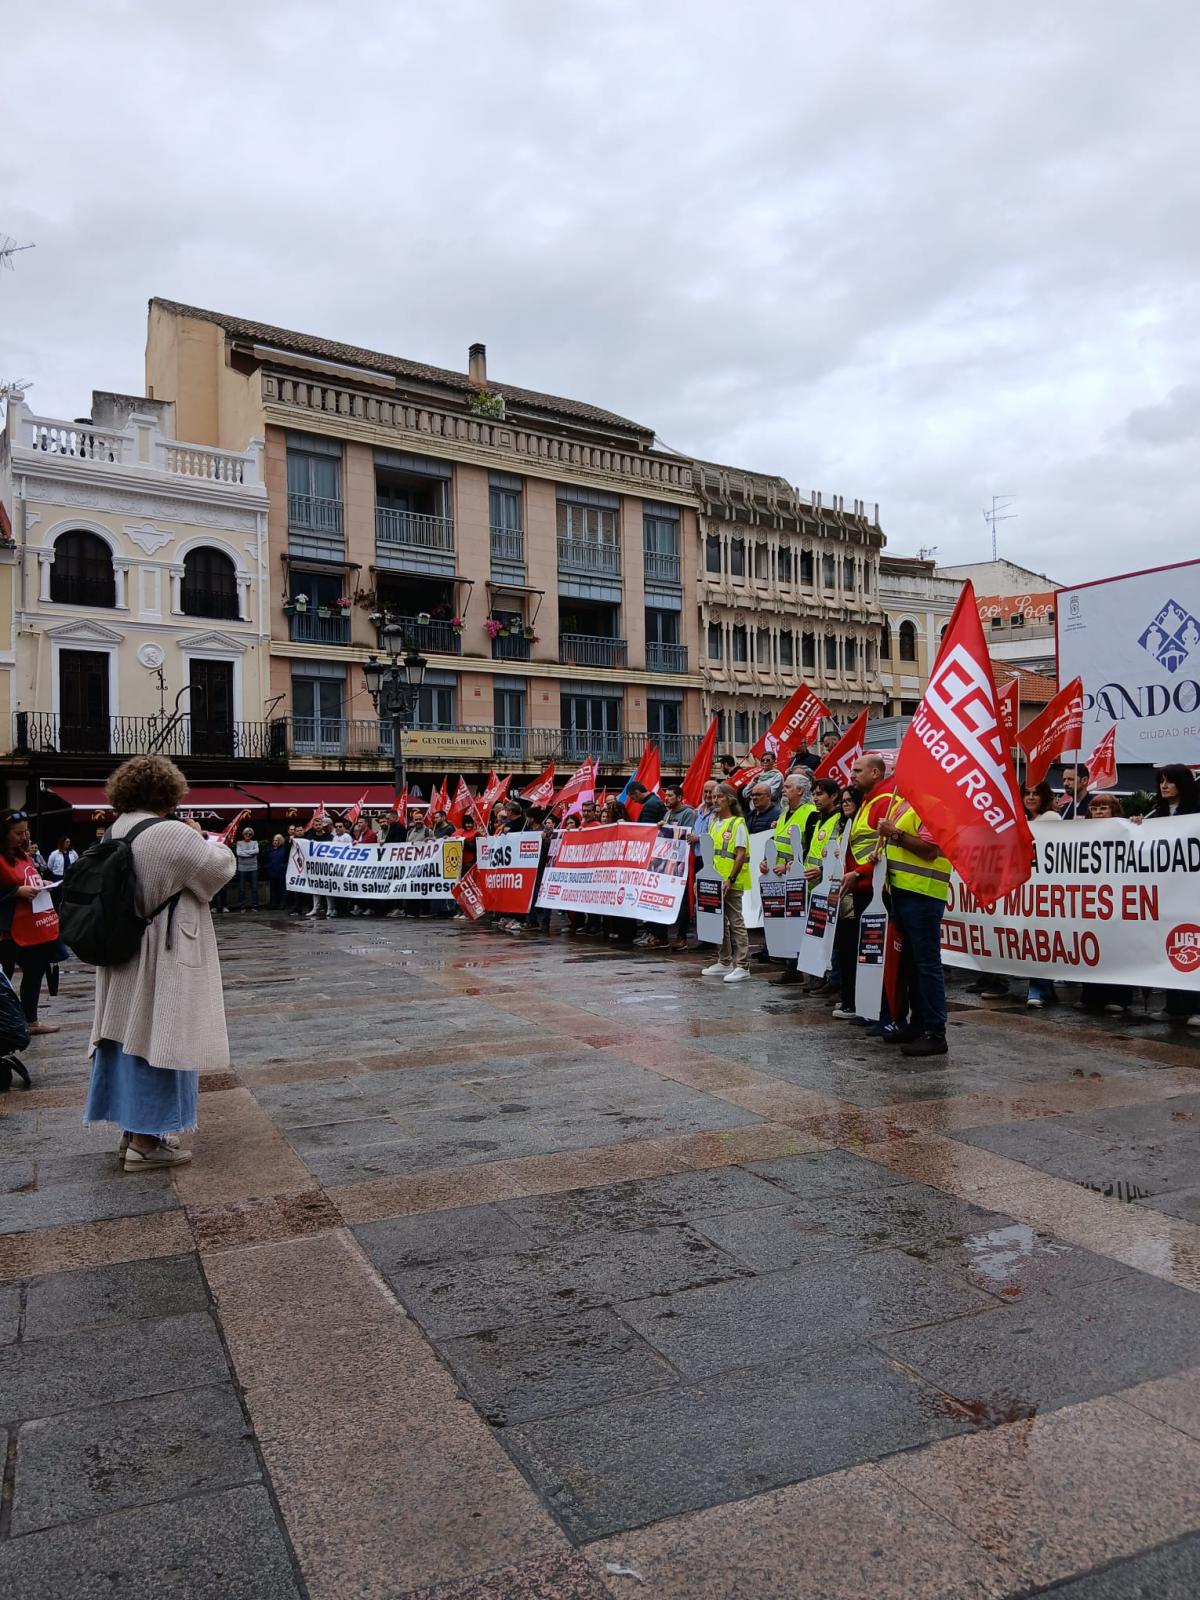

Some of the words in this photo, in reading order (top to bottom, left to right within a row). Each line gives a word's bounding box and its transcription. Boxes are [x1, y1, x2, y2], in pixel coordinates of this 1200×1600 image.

[422, 735, 459, 745] GESTORÍA
[1139, 729, 1180, 740] CIUDAD
[955, 768, 1017, 834] Real
[376, 847, 387, 861] Y
[389, 843, 440, 862] FREMAP
[1044, 837, 1200, 875] SINIESTRALIDAD
[305, 860, 347, 877] PROVOCAN
[346, 864, 405, 880] ENFERMEDAD
[289, 876, 306, 886] sin
[343, 880, 359, 893] sin
[392, 881, 407, 893] sin
[1003, 884, 1114, 921] MUERTES
[1121, 885, 1159, 921] EN
[969, 924, 992, 957] EL
[994, 926, 1100, 967] TRABAJO
